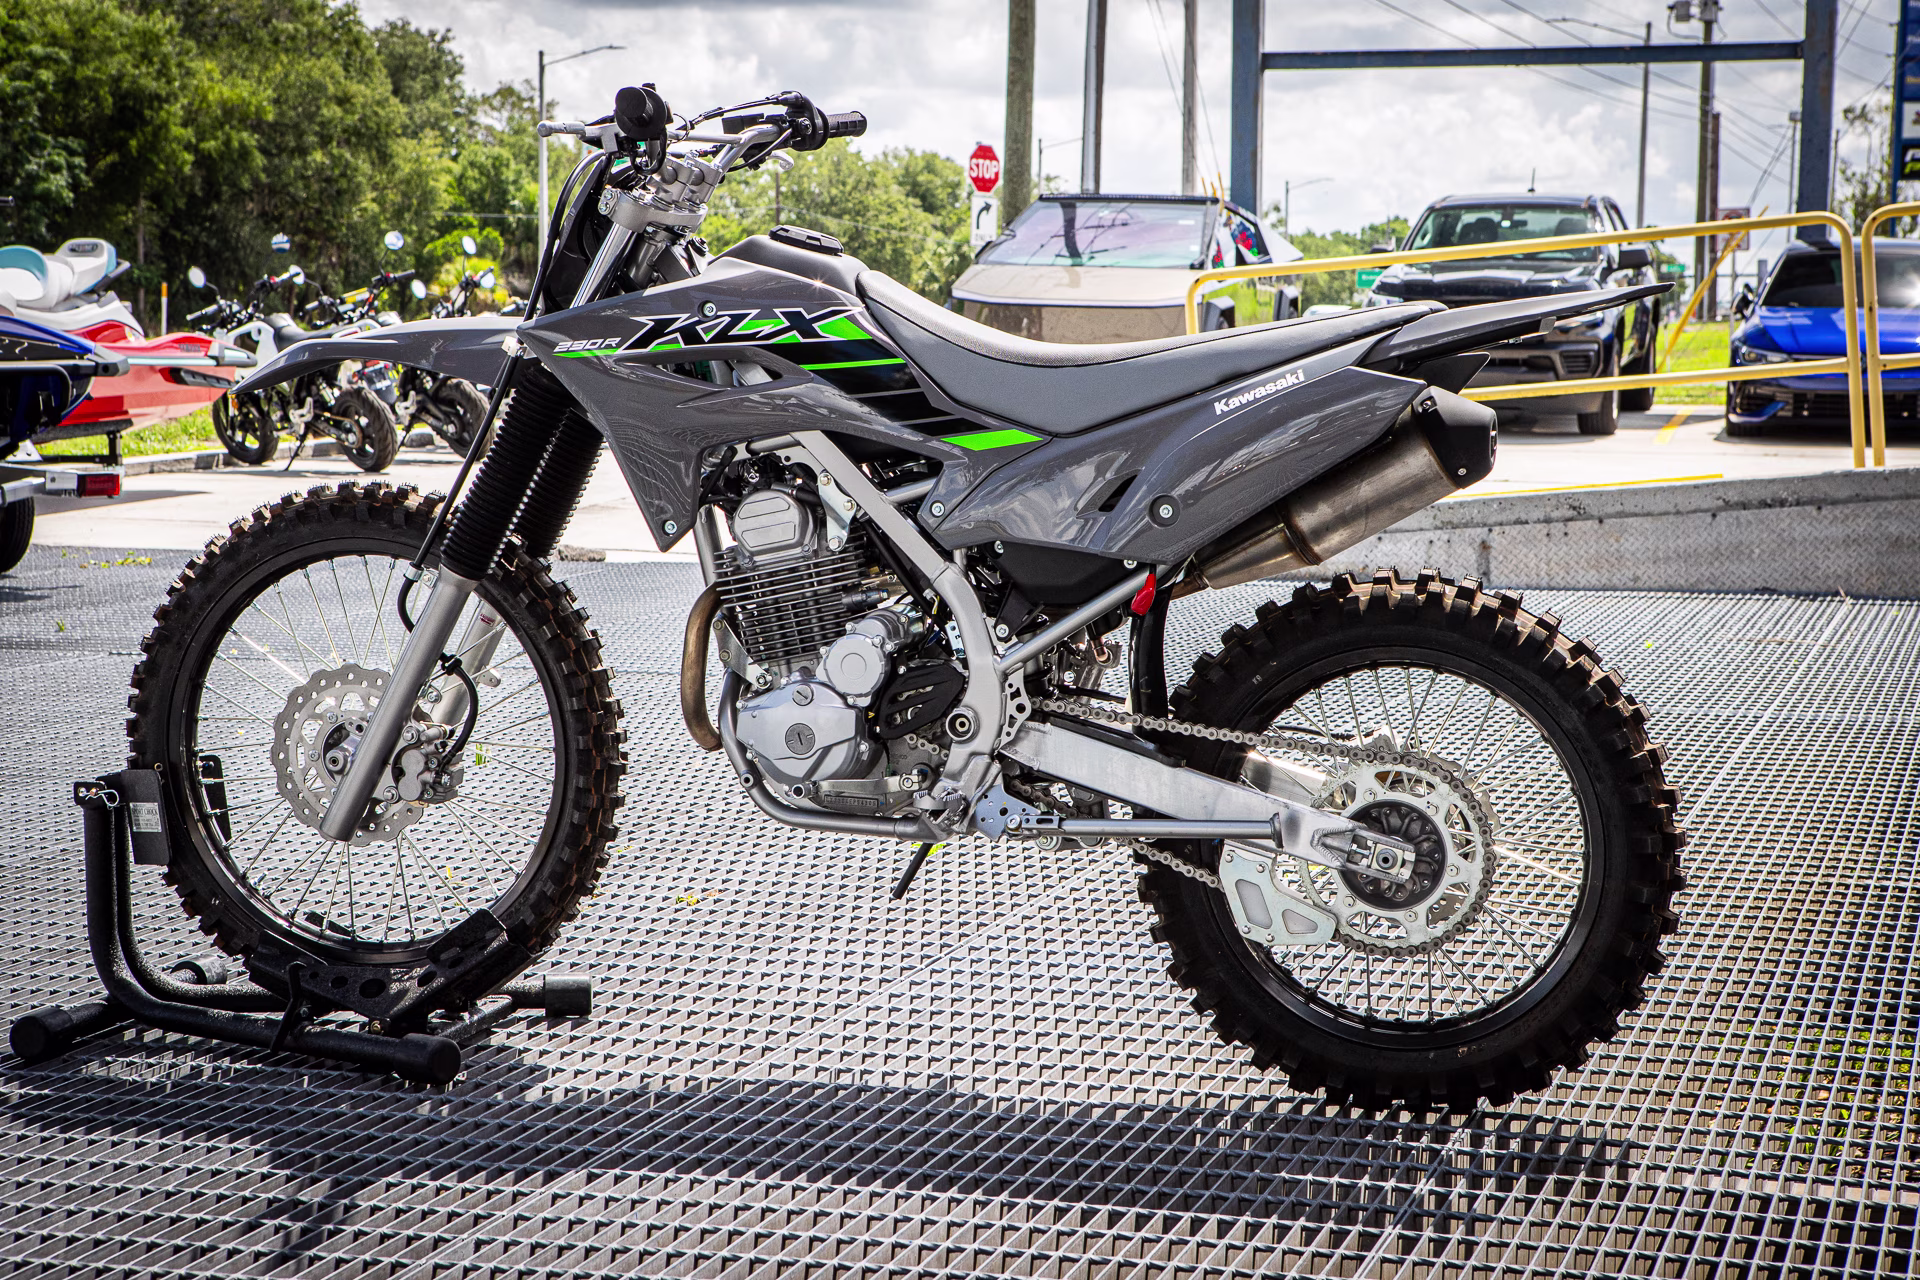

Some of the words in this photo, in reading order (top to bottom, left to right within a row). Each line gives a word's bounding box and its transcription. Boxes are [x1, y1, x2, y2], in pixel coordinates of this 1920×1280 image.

[970, 158, 999, 179] STOP
[554, 337, 621, 353] 230R
[612, 308, 866, 353] KLX
[1213, 368, 1305, 415] Kawasaki
